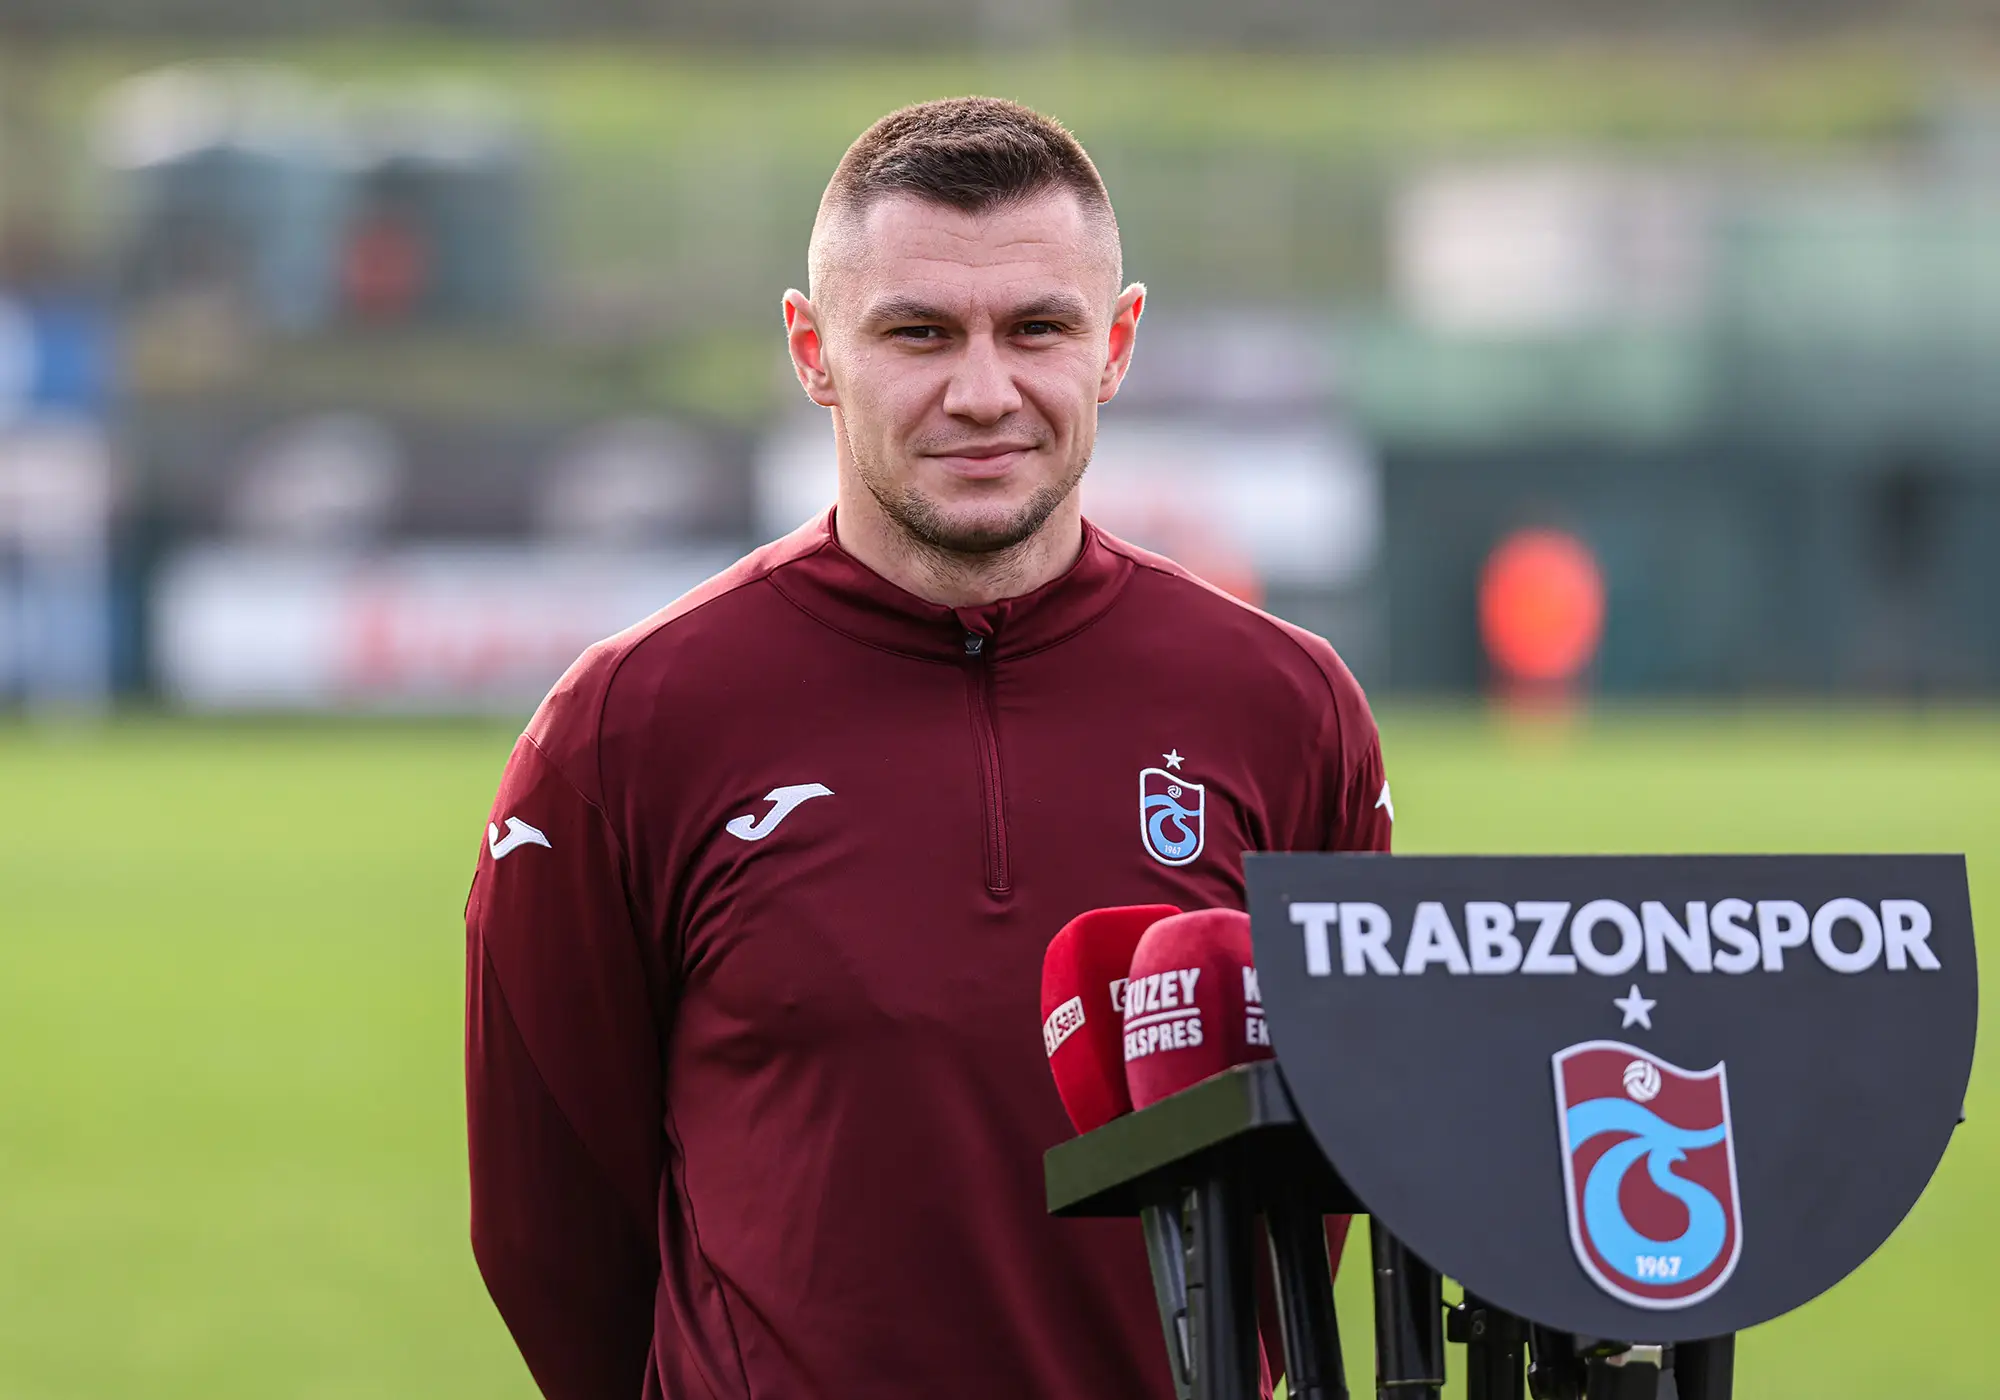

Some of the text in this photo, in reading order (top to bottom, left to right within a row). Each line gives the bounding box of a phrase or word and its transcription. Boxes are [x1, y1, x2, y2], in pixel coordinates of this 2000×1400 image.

[1164, 844, 1182, 855] 1967
[1289, 898, 1941, 976] TRABZONSPOR
[1124, 1018, 1203, 1062] EKSPRES
[1636, 1256, 1682, 1277] 1967
